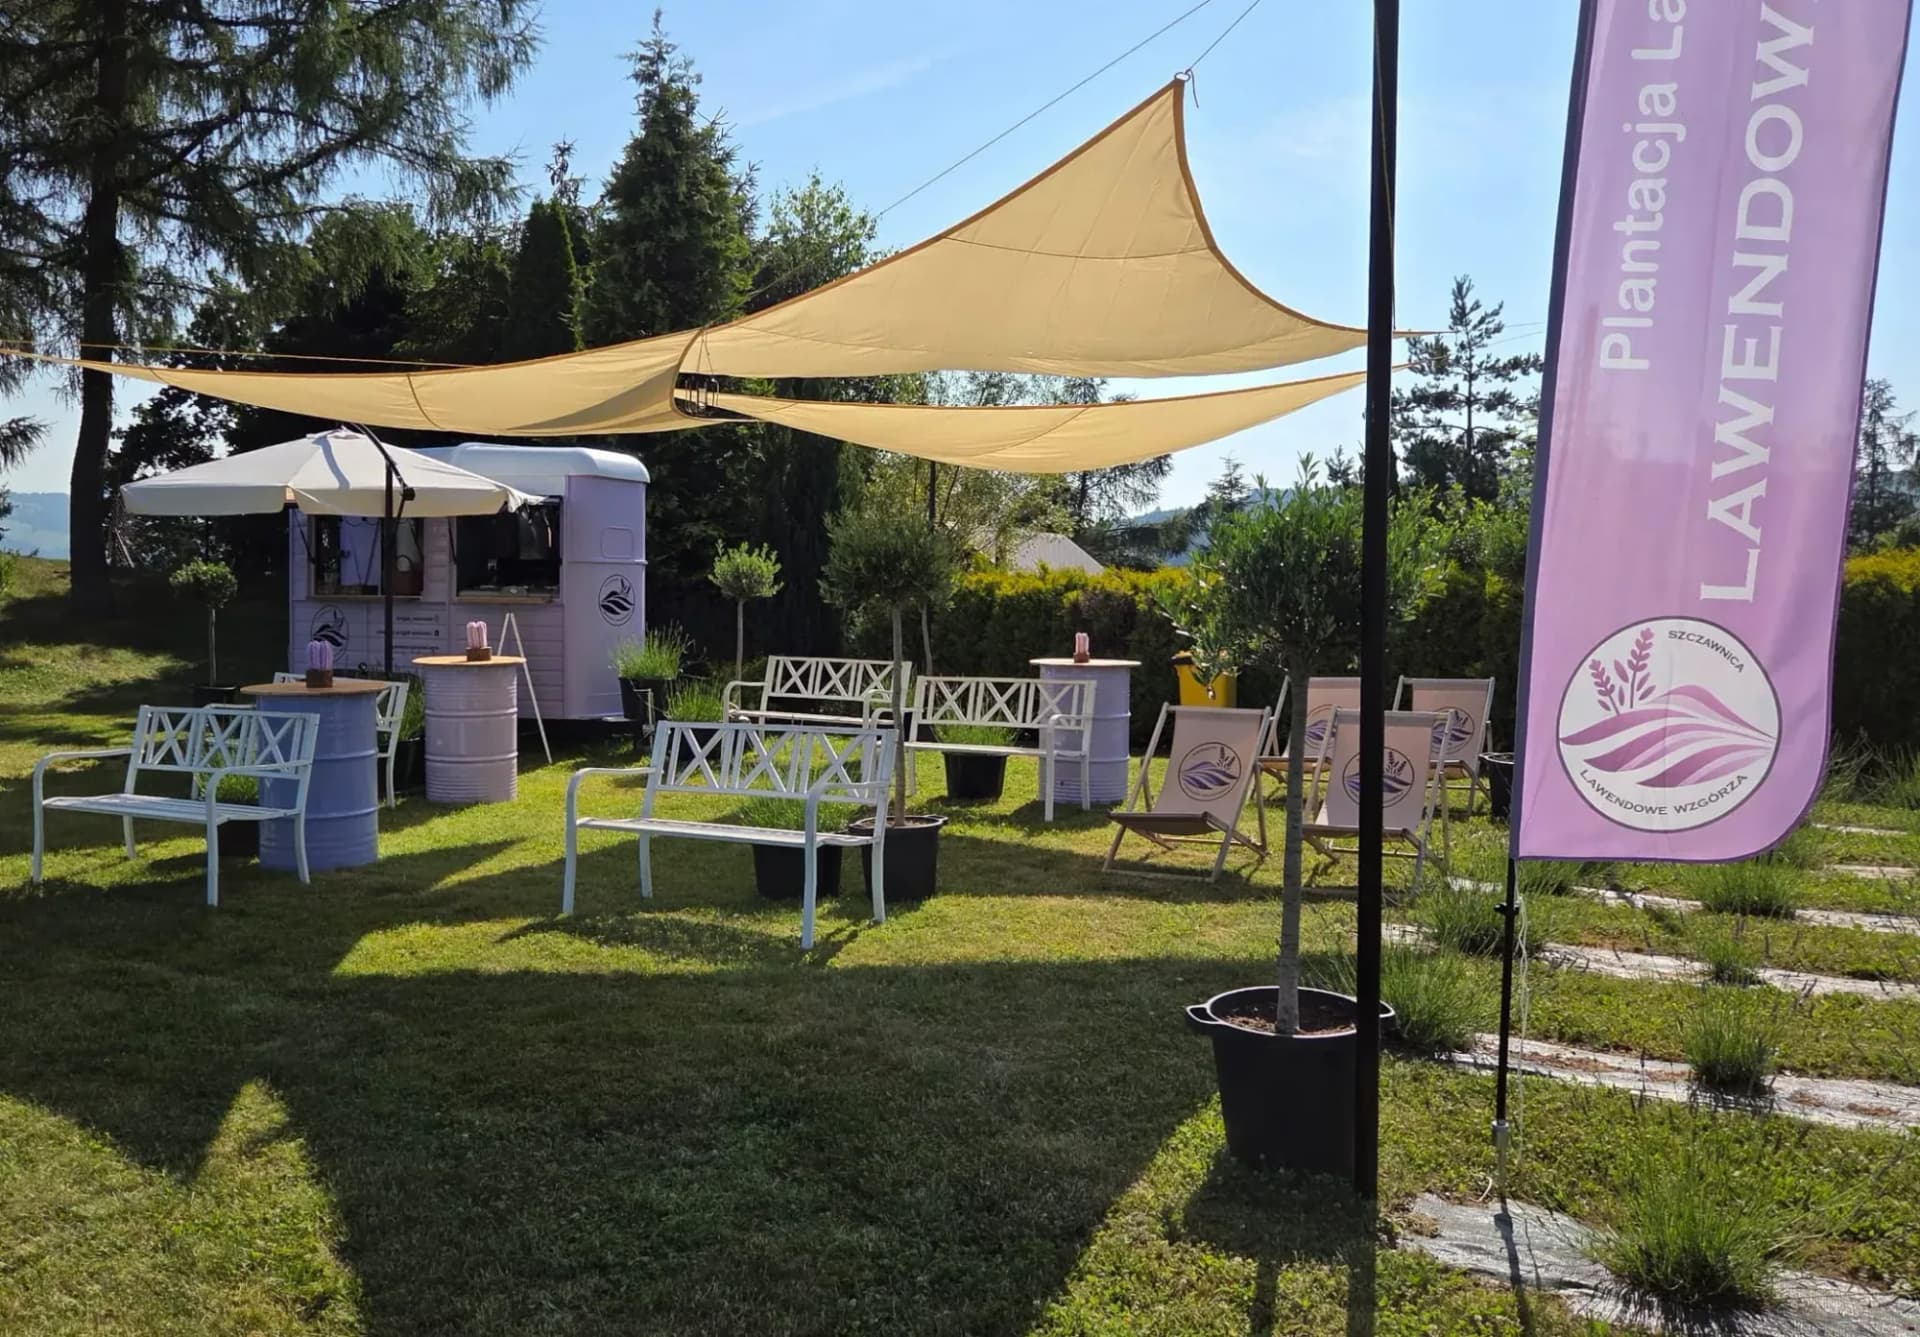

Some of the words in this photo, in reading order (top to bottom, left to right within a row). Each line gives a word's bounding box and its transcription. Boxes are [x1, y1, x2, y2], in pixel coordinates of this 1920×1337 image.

[1599, 81, 1687, 370] Plantacja
[1699, 0, 1818, 603] LAWENDOW
[1668, 630, 1745, 673] SZCZAWNICA
[1580, 769, 1668, 815] LAWENDOWE
[1674, 774, 1748, 814] WZGÓRZA
